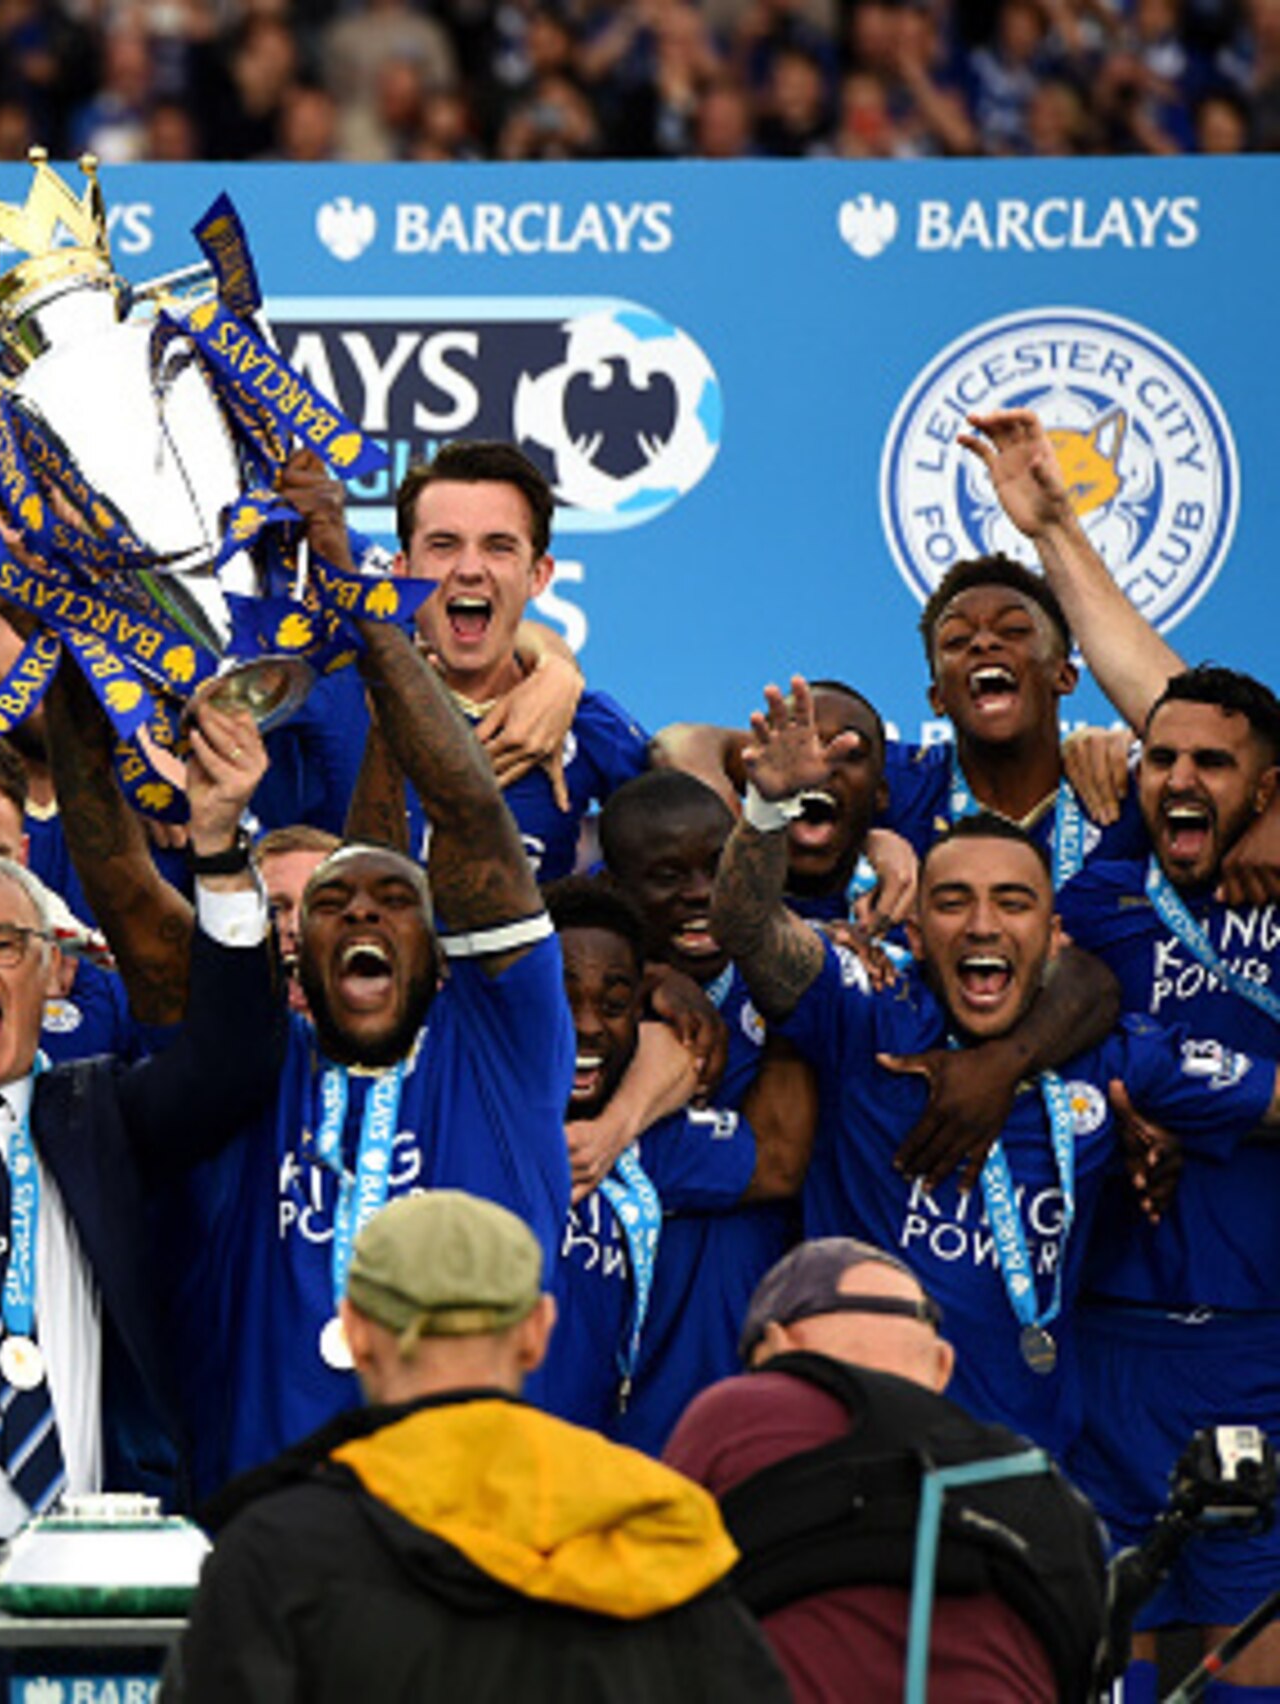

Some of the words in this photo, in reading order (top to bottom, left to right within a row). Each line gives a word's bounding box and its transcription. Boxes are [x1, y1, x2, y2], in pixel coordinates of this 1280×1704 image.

[395, 203, 674, 255] BARCLAYS
[917, 197, 1199, 250] BARCLAYS
[207, 321, 340, 444] BARCLAYS
[915, 340, 1133, 473] LEICESTER
[1135, 375, 1208, 474] CITY
[1122, 500, 1208, 608] CLUB
[900, 1213, 1058, 1275] POWR
